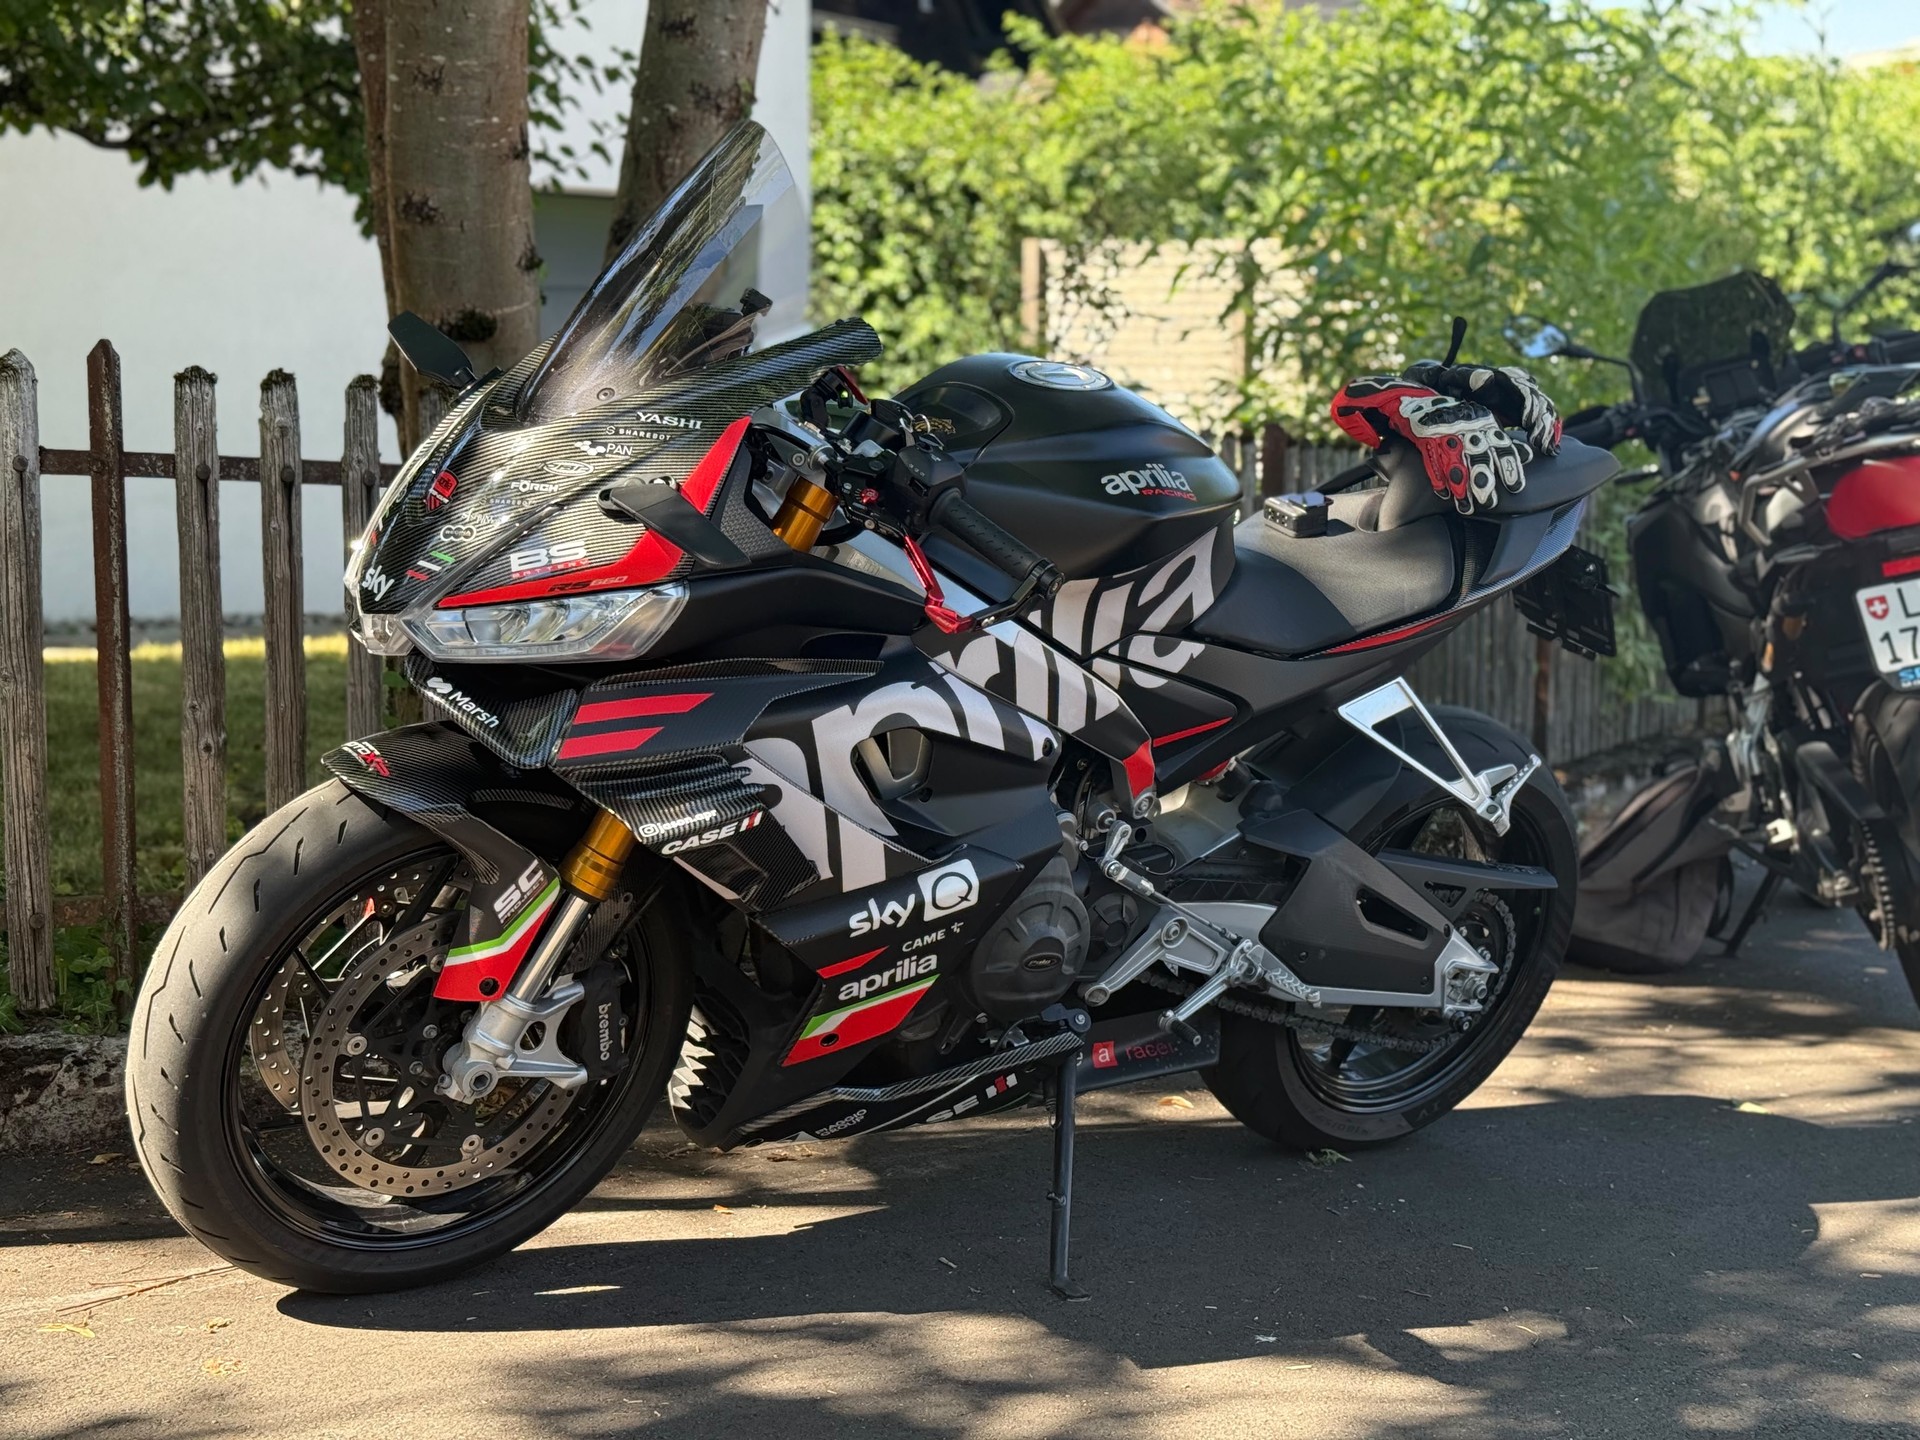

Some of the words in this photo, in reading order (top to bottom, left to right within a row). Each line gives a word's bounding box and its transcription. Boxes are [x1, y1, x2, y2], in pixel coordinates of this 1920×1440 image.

[618, 428, 672, 441] SHAREBOT
[637, 412, 702, 430] YASHI
[606, 443, 633, 456] PAN
[1101, 463, 1193, 495] aprilia
[1141, 488, 1198, 502] RACING
[510, 540, 587, 572] BS
[511, 558, 590, 579] BATTERY
[361, 565, 395, 602] sky
[449, 690, 500, 729] Marsh
[661, 821, 739, 855] CASE
[493, 859, 544, 920] SC
[499, 874, 546, 924] PROJECT
[849, 893, 916, 938] sky
[902, 929, 946, 953] CAME
[838, 953, 938, 1001] aprilia
[598, 1002, 613, 1061] brembo
[1098, 1047, 1111, 1063] a
